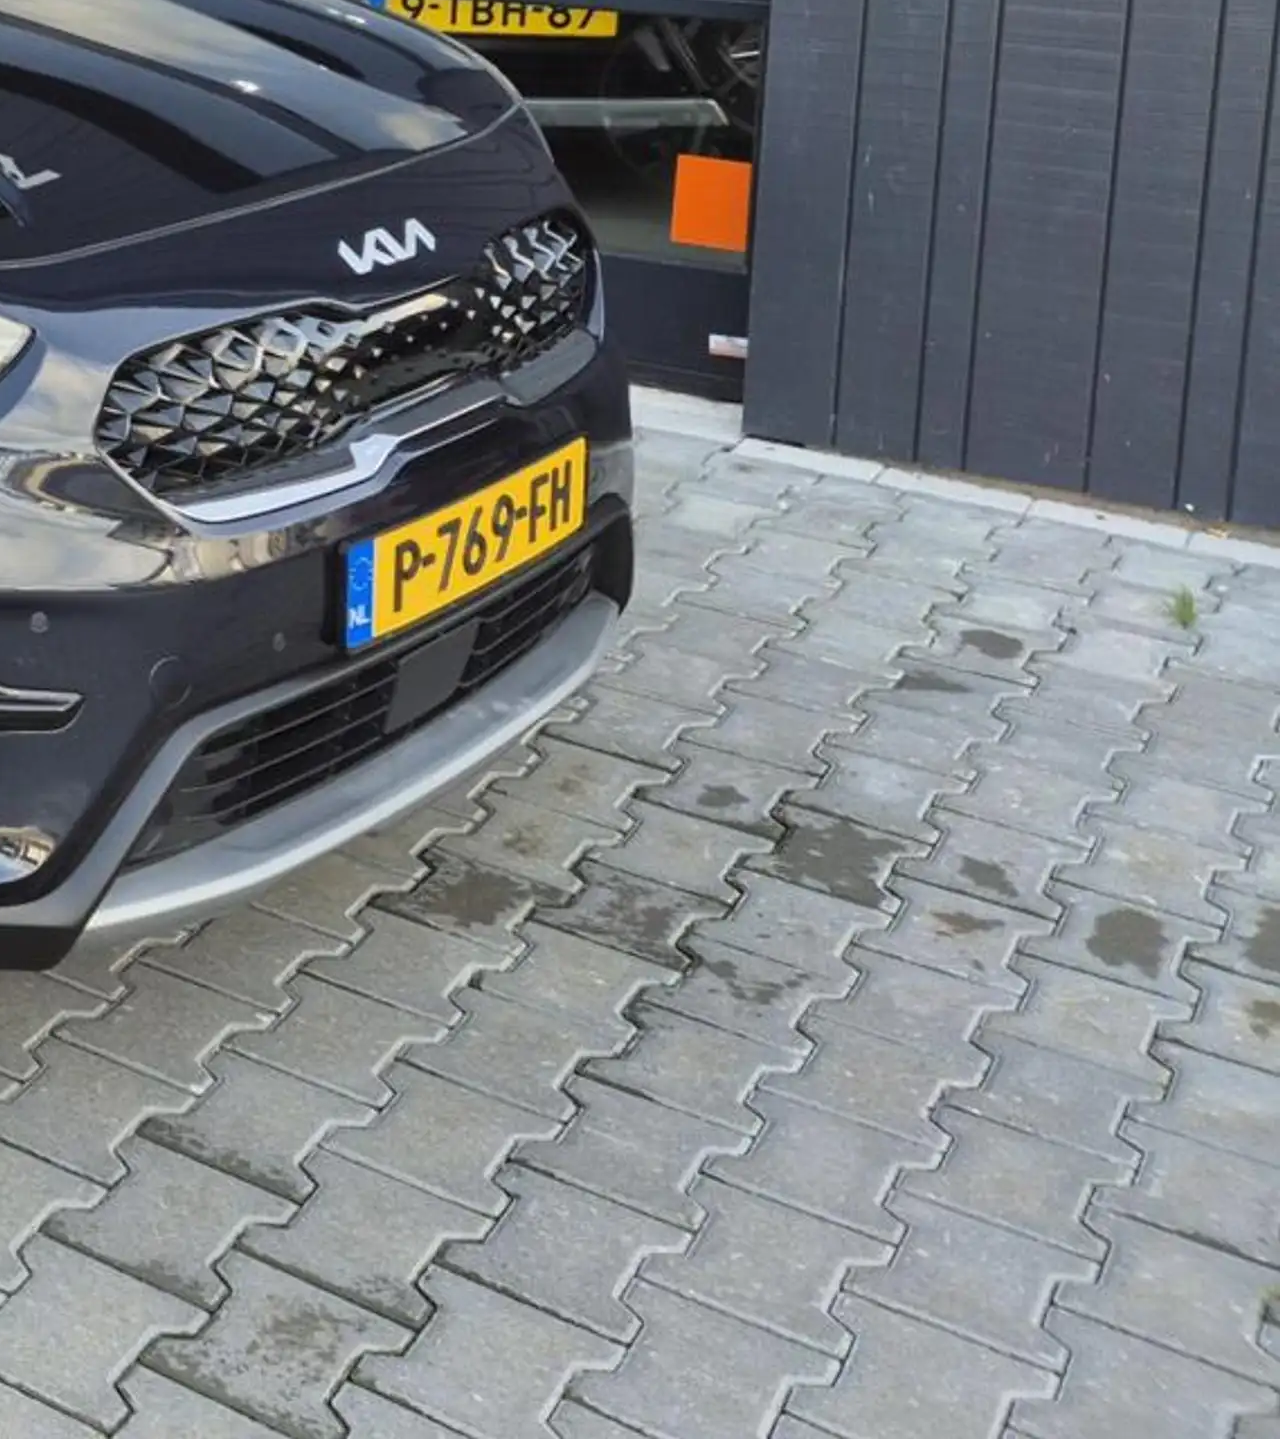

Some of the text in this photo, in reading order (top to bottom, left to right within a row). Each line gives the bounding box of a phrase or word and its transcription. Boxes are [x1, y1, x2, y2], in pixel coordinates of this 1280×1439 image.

[337, 217, 437, 275] KIA
[392, 458, 574, 613] P-769-FH
[347, 607, 372, 629] NL
